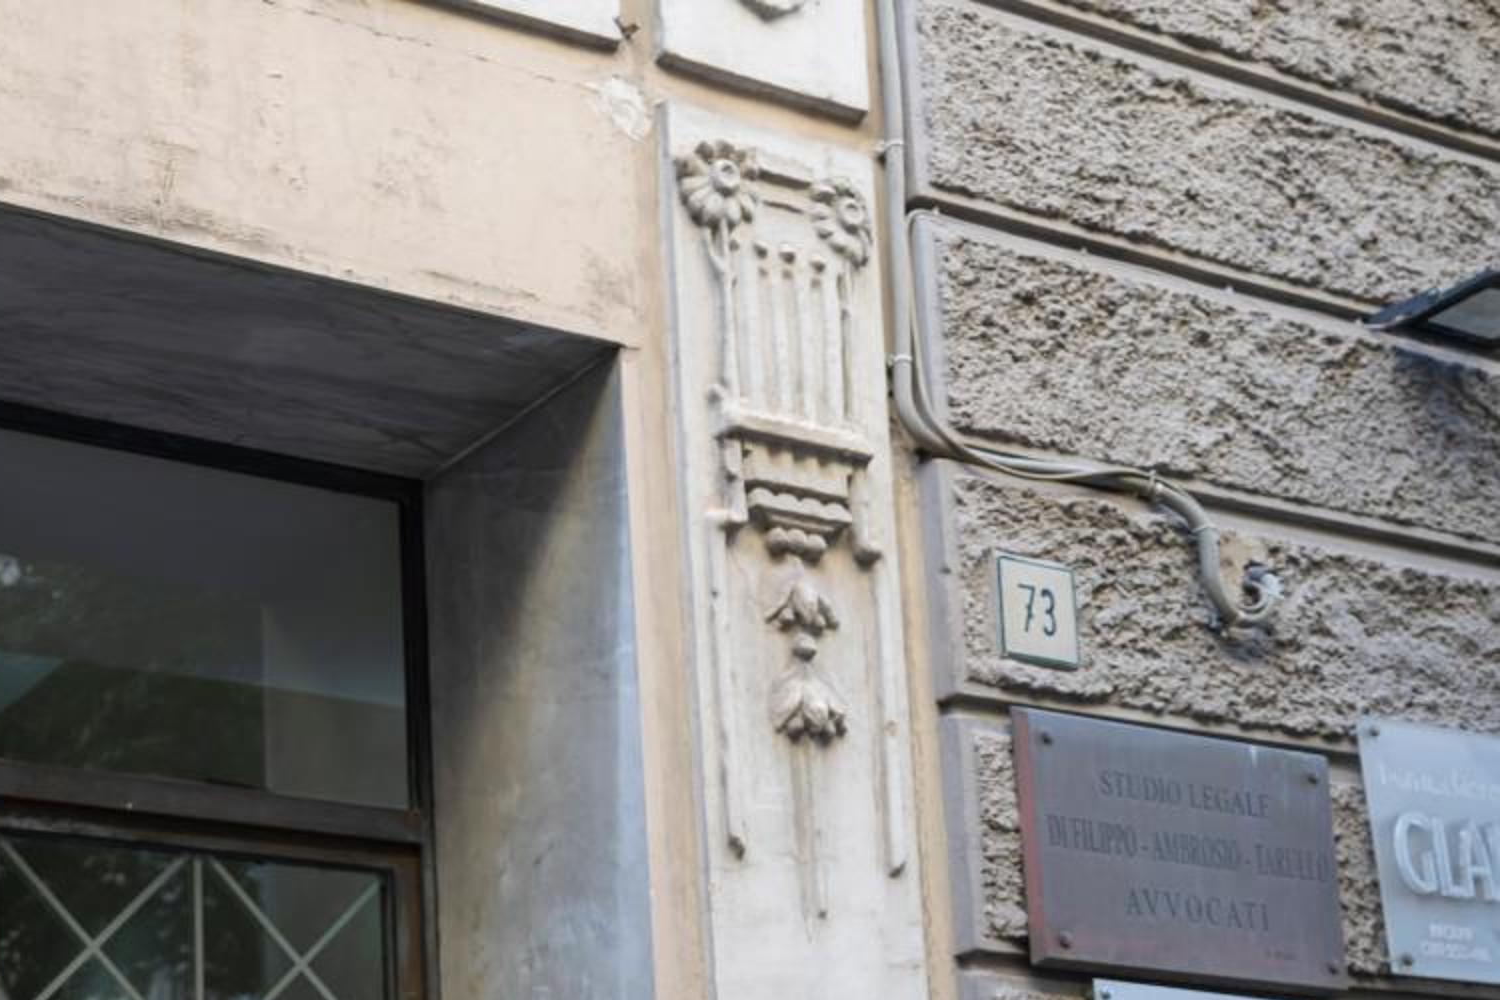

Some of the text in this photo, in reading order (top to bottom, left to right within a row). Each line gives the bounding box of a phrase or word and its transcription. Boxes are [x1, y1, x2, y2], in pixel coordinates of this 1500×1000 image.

[1017, 582, 1057, 638] 73
[1100, 770, 1269, 818] STUDIO LEGALE
[1046, 814, 1067, 848] DI
[1072, 817, 1138, 858] FILIPPO
[1393, 811, 1500, 902] GLA
[1124, 887, 1269, 932] AVVOCATI
